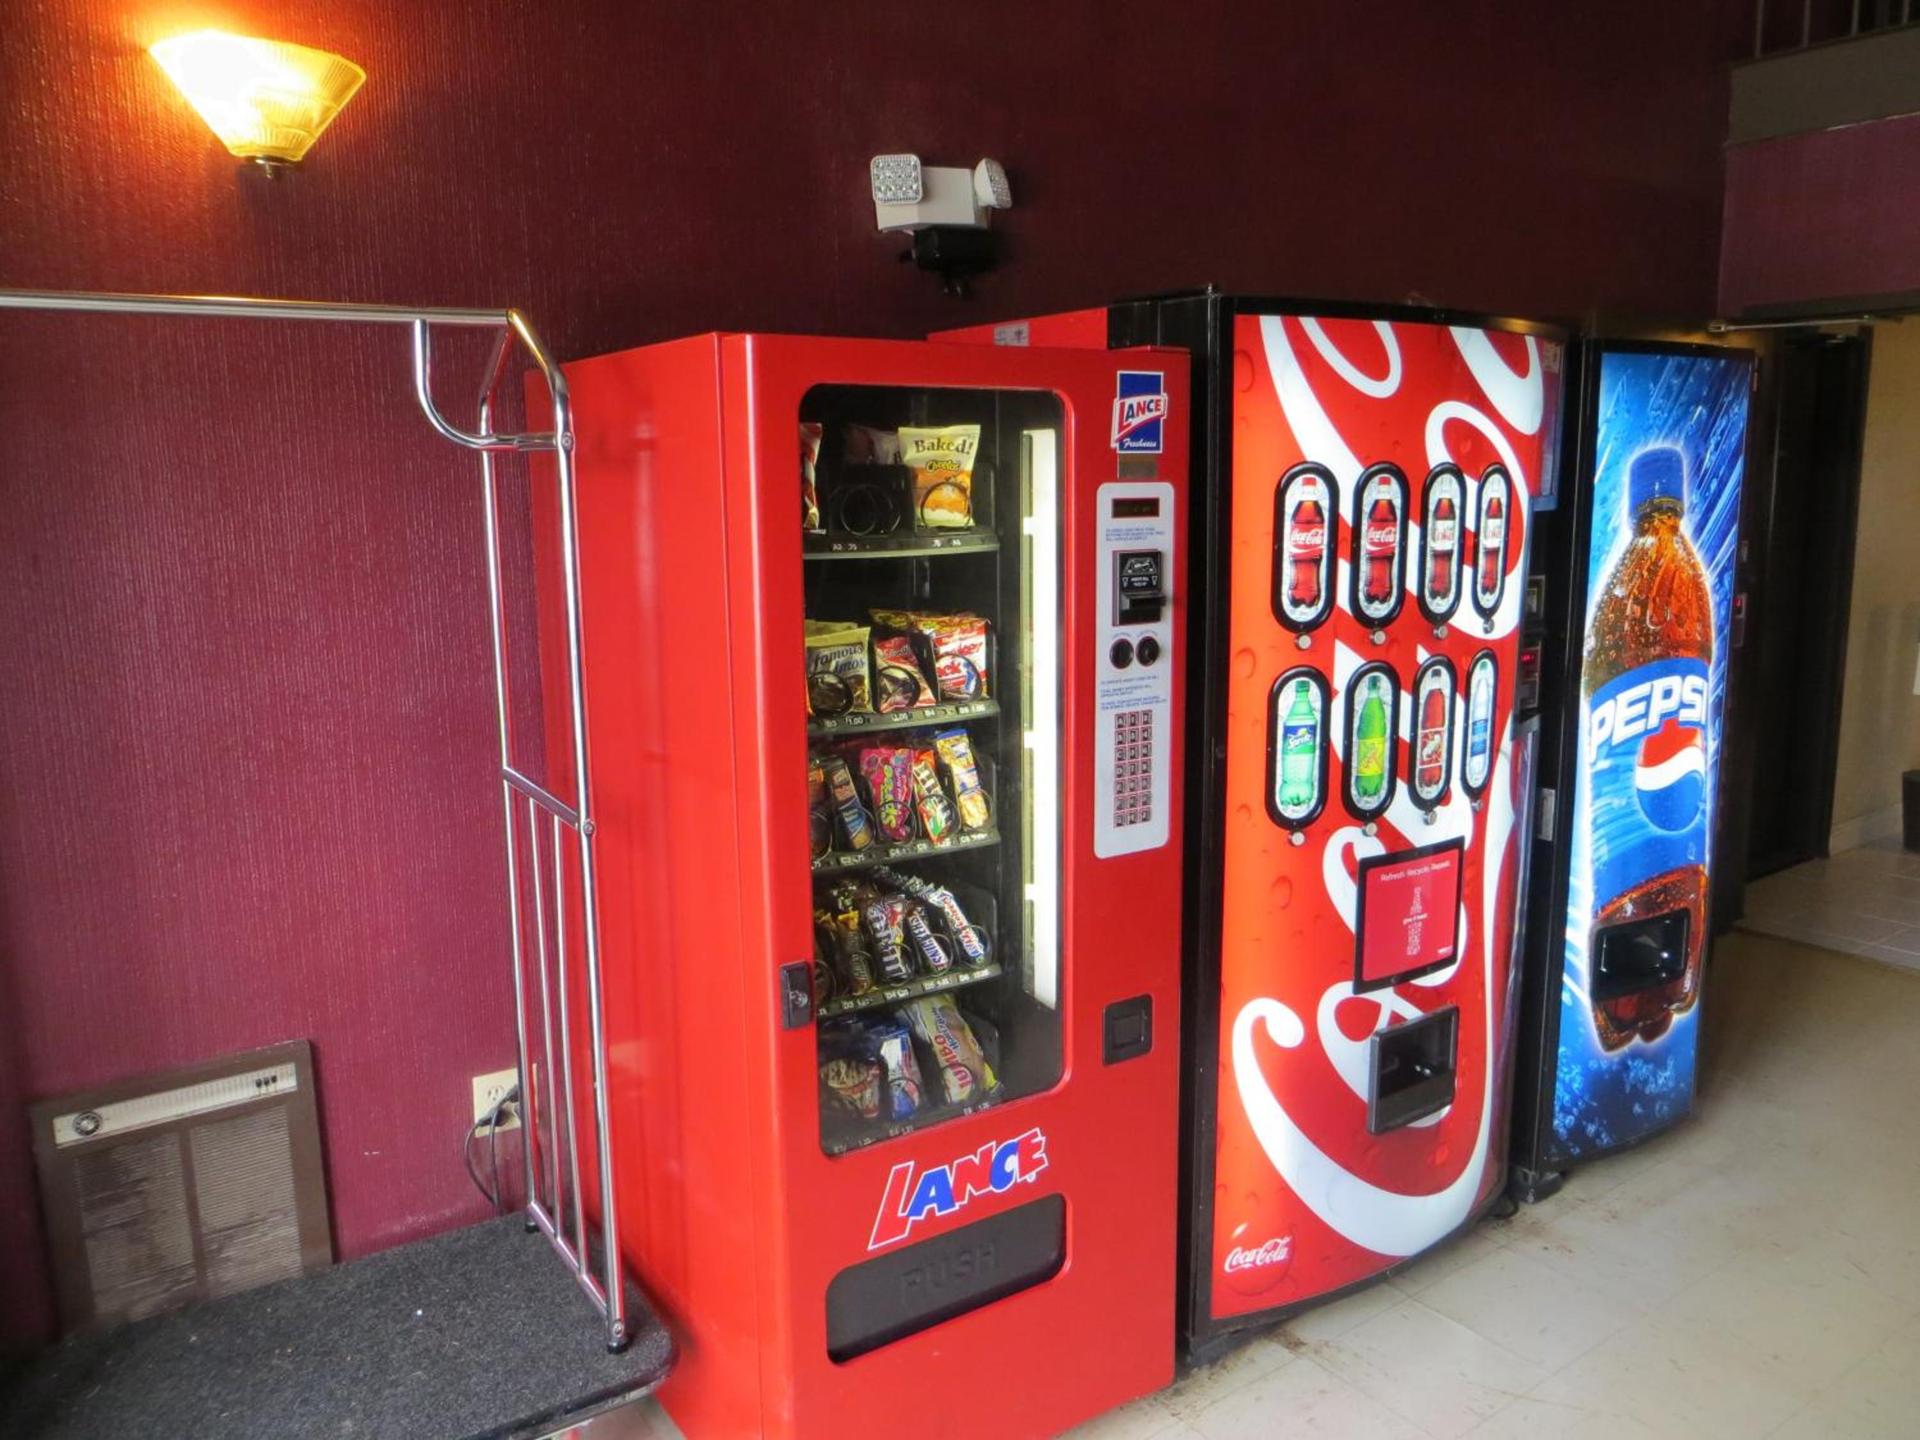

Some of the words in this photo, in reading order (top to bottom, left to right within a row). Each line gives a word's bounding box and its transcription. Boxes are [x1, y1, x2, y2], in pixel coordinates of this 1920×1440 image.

[1116, 398, 1162, 434] LANCE
[914, 436, 974, 456] Baked!
[1122, 437, 1157, 449] Freshness
[1590, 675, 1708, 765] PEPSI
[867, 1127, 1049, 1251] LANCE
[1224, 1235, 1292, 1273] Coca-Cola
